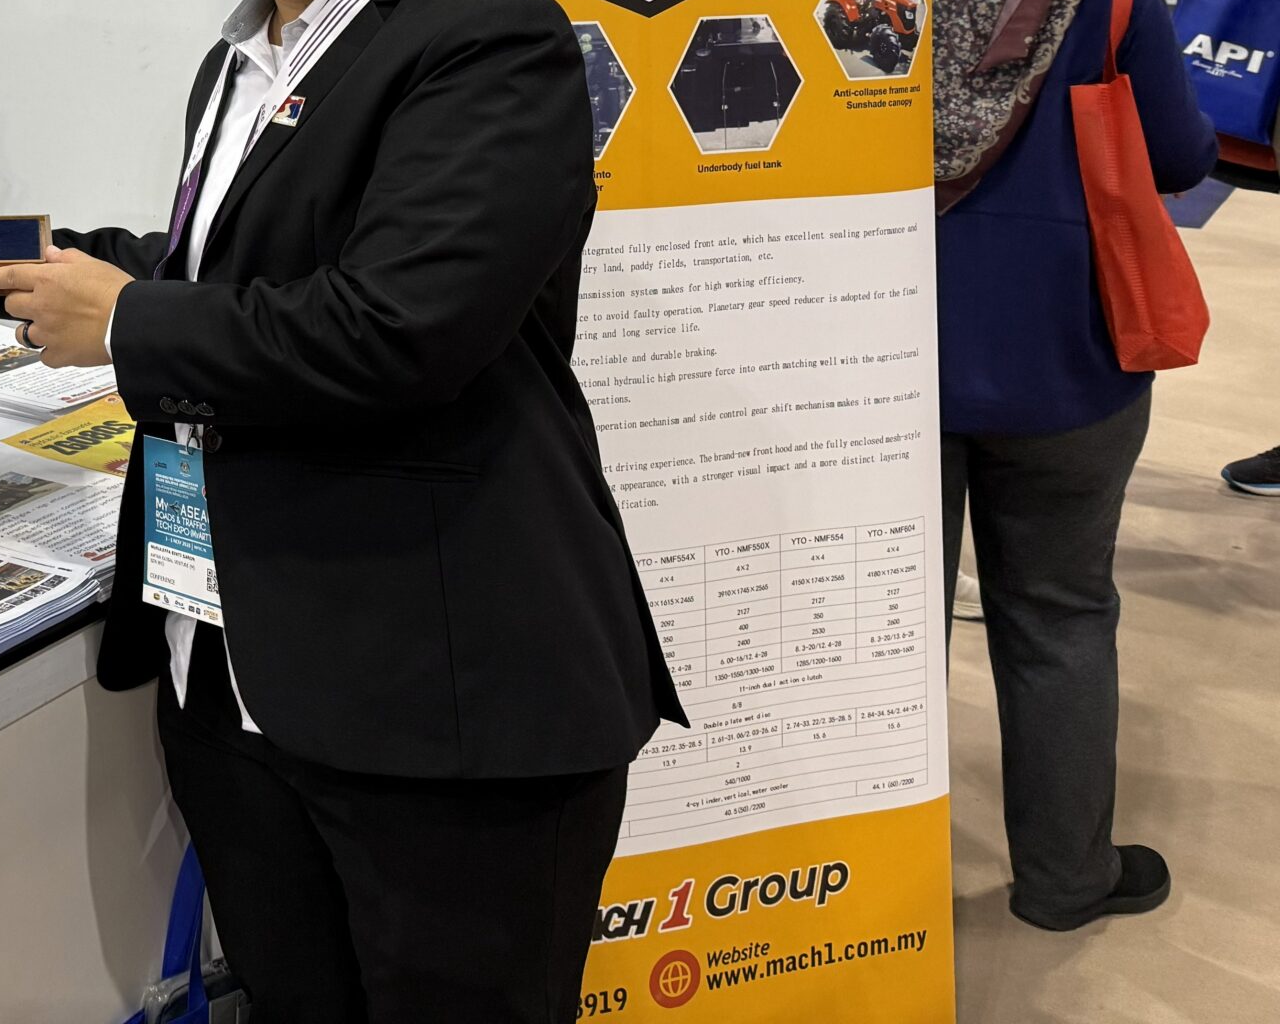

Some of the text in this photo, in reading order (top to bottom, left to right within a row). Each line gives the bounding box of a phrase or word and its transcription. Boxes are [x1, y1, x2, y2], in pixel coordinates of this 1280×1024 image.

[1183, 34, 1264, 73] API
[833, 85, 921, 98] Anti-collapse frame and
[847, 98, 912, 110] Sunshade canopy
[698, 160, 782, 174] Underbody fuel tank
[629, 243, 651, 254] fully
[656, 241, 690, 251] enclosed
[694, 239, 714, 248] front
[718, 238, 737, 246] axle,
[743, 232, 763, 244] which
[768, 234, 781, 243] has
[785, 232, 824, 241] excellent
[830, 229, 860, 239] sealing
[863, 226, 905, 238] performance
[583, 252, 773, 275] dry land, paddy fields, transportation, etc.
[631, 288, 658, 298] system
[662, 285, 684, 295] makes
[688, 283, 701, 292] for
[705, 281, 722, 291] high
[726, 278, 754, 289] working
[759, 276, 805, 287] efficiency.
[593, 286, 918, 321] to avoid faulty operation. Planetary gear speed reducer is adopted for the final
[602, 329, 616, 338] and
[623, 328, 640, 337] long
[645, 326, 676, 335] service
[682, 323, 700, 332] life.
[596, 390, 920, 432] operation mechanism and side control gear shift mechanism makes it more suitable
[658, 879, 695, 933] 1
[705, 860, 850, 919] Group
[706, 941, 770, 968] Website
[706, 929, 927, 991] www.mach1.com.my
